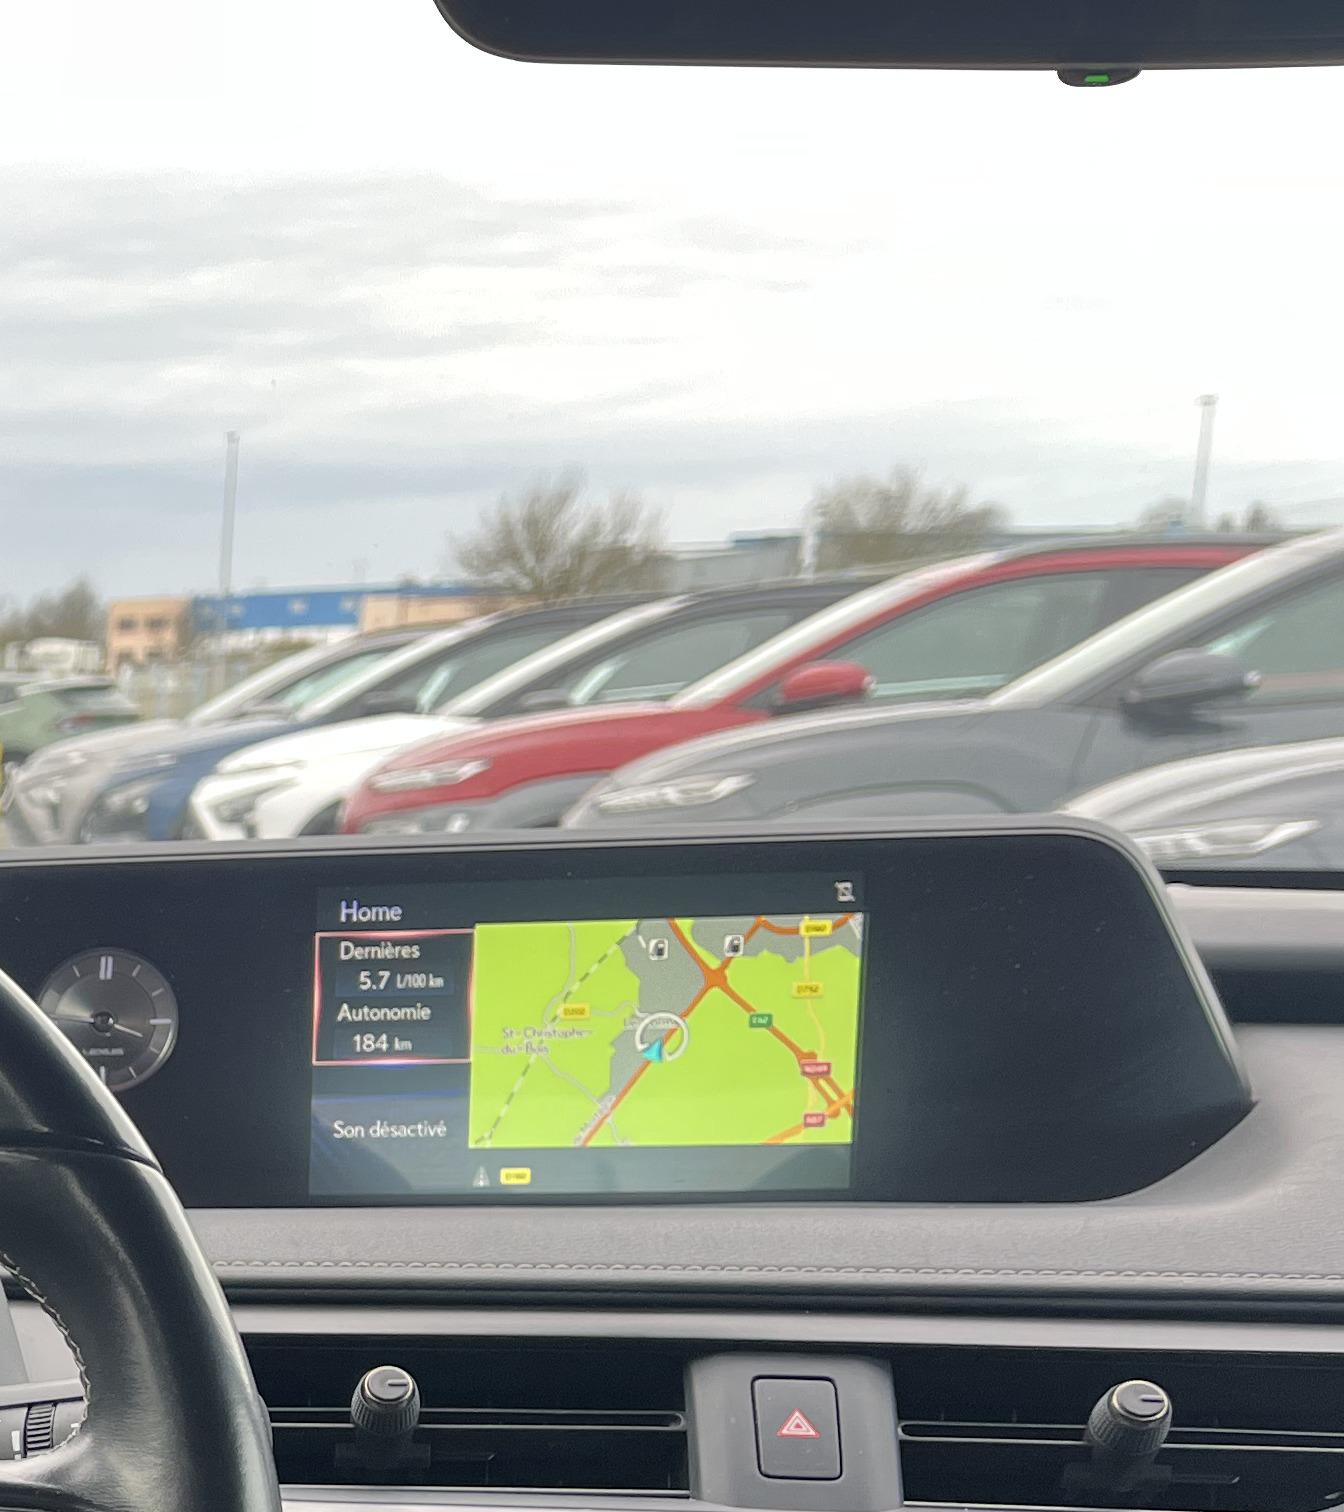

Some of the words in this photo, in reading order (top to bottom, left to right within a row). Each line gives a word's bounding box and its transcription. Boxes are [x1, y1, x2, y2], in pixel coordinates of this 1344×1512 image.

[339, 900, 403, 923] Home
[339, 941, 420, 961] Dernières
[359, 971, 391, 990] 5.7
[428, 973, 445, 988] km
[336, 1003, 431, 1022] Autonomie
[353, 1033, 389, 1052] 184
[394, 1037, 412, 1051] km
[333, 1121, 365, 1139] Son
[369, 1119, 448, 1138] désactivé
